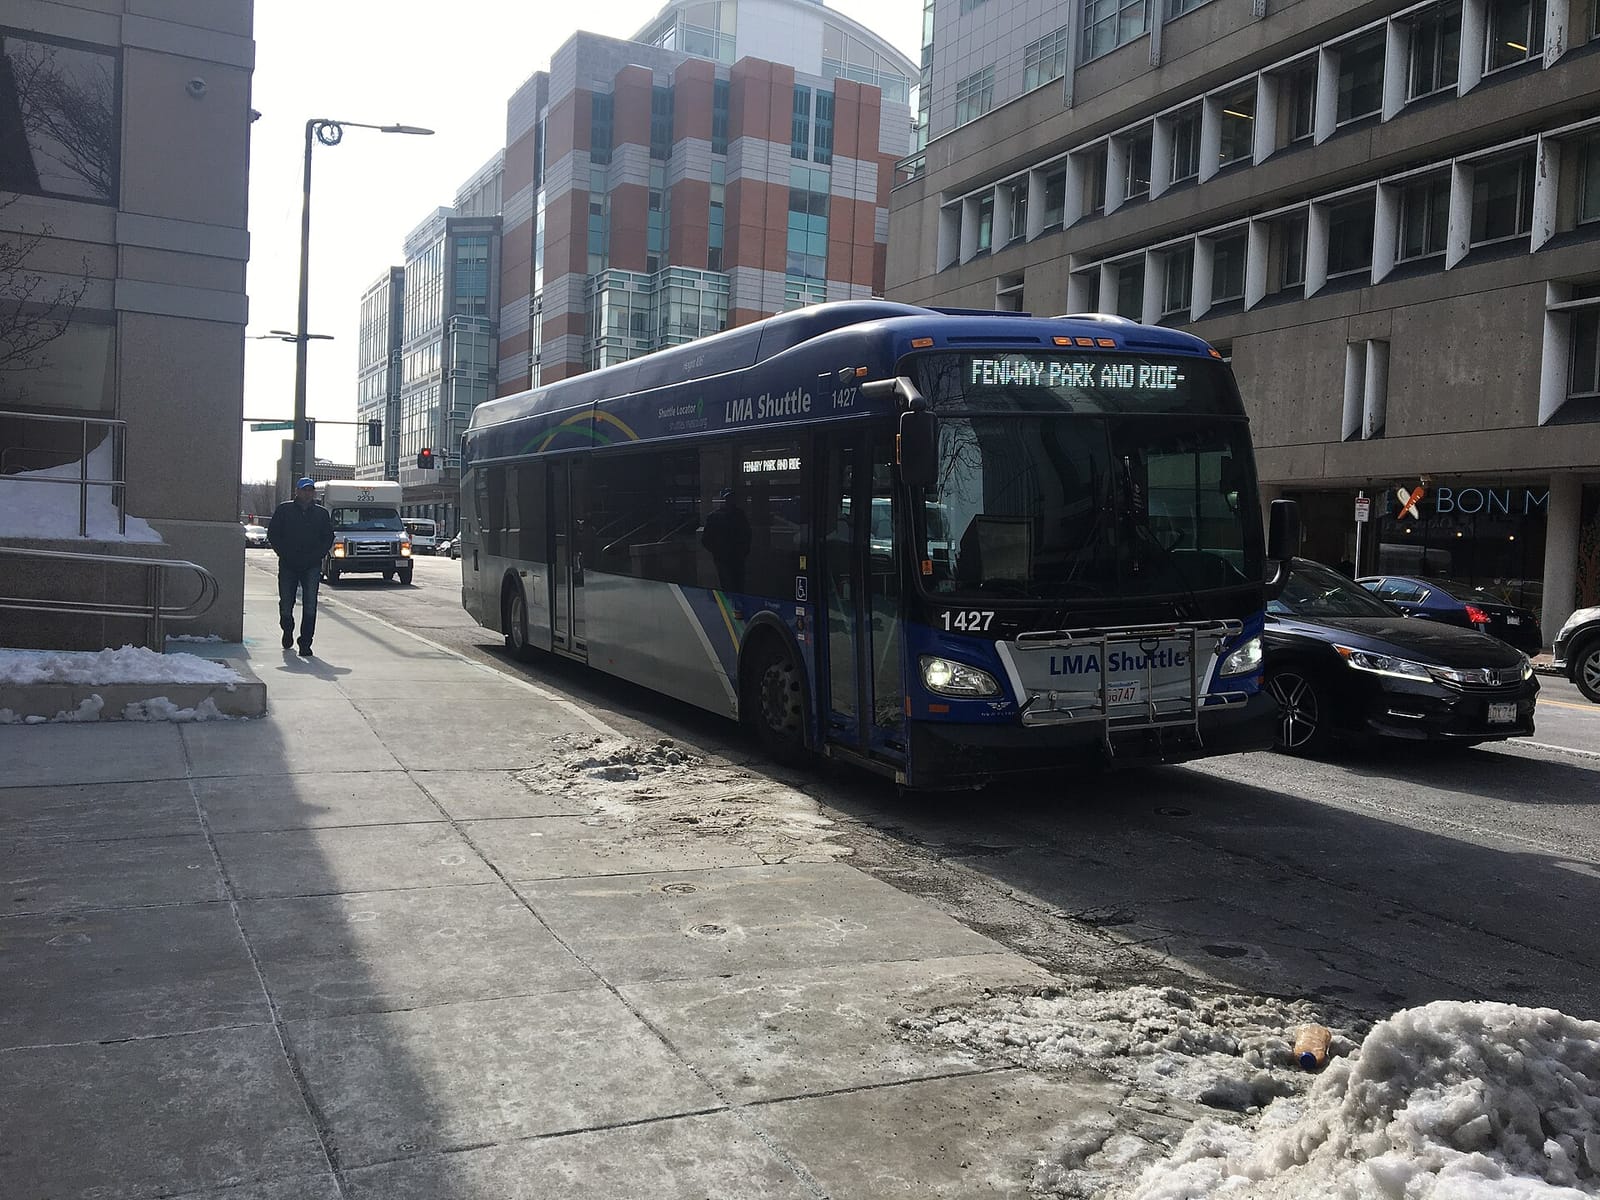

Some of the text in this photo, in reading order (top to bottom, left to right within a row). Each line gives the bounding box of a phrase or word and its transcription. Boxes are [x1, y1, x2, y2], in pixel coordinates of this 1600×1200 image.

[972, 359, 1045, 386] FENWAY
[1049, 362, 1096, 387] PARK
[1100, 363, 1135, 388] AND
[658, 403, 697, 418] Shuttle Locator
[725, 387, 811, 423] LMA Shuttle
[831, 387, 858, 409] 1427
[763, 459, 777, 471] PARK
[776, 458, 788, 471] AND
[1437, 487, 1510, 515] BON
[941, 611, 995, 632] 1427
[1050, 648, 1184, 676] LMA Shuttle
